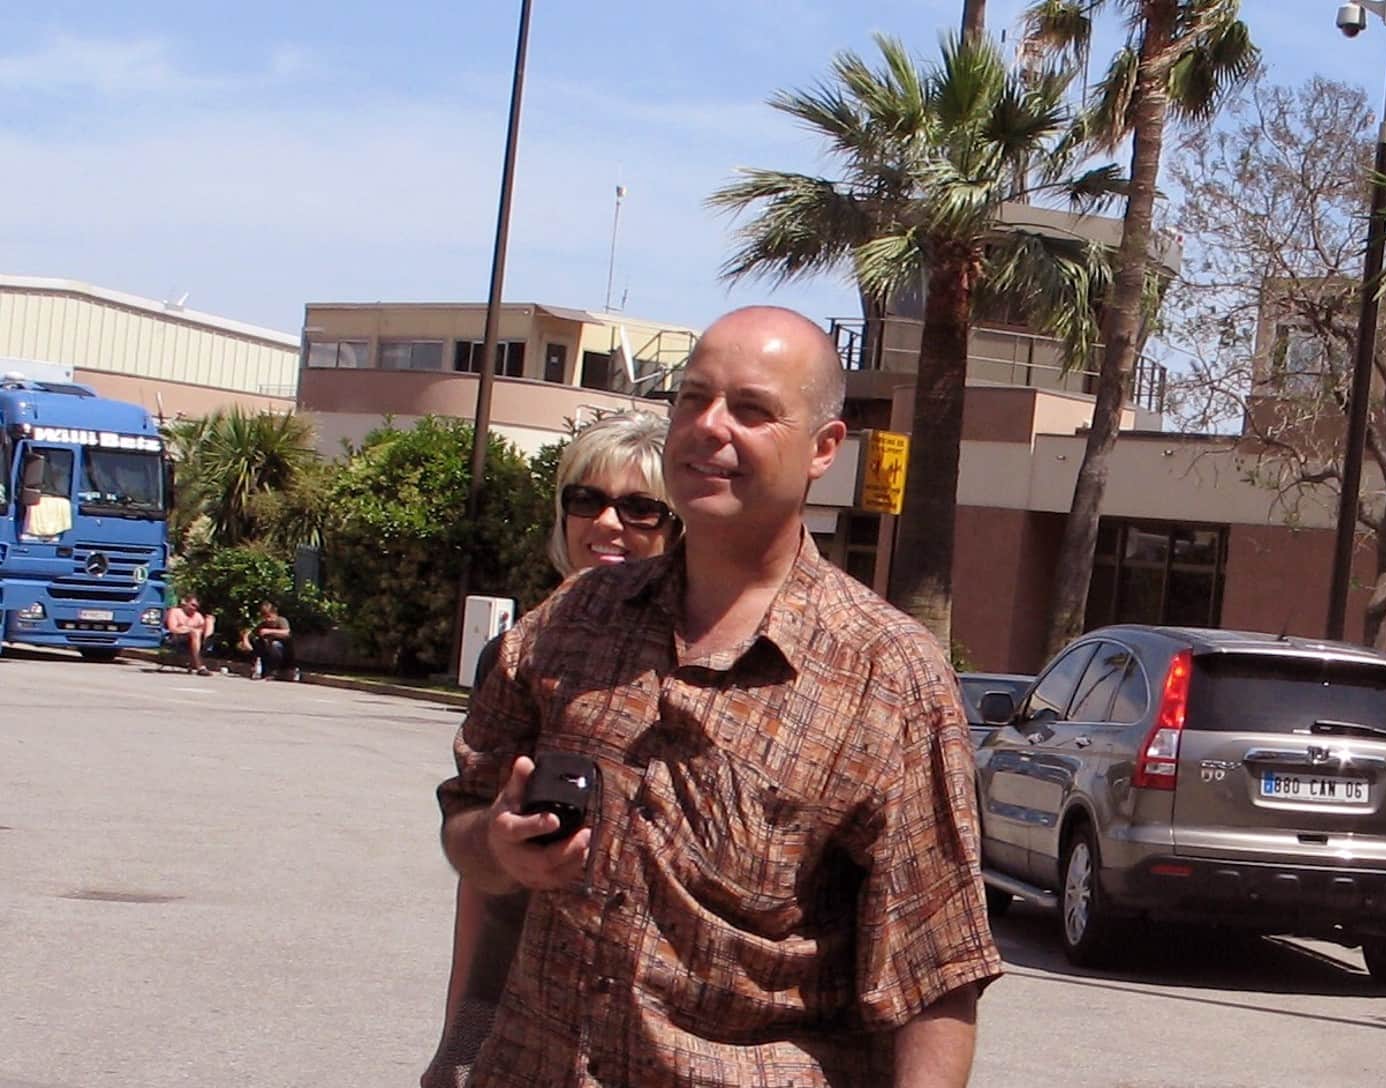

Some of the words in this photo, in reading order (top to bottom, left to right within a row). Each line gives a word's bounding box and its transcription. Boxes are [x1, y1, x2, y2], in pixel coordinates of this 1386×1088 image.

[1274, 776, 1300, 794] 880
[1310, 779, 1336, 797] CAN
[1346, 782, 1363, 799] 06
